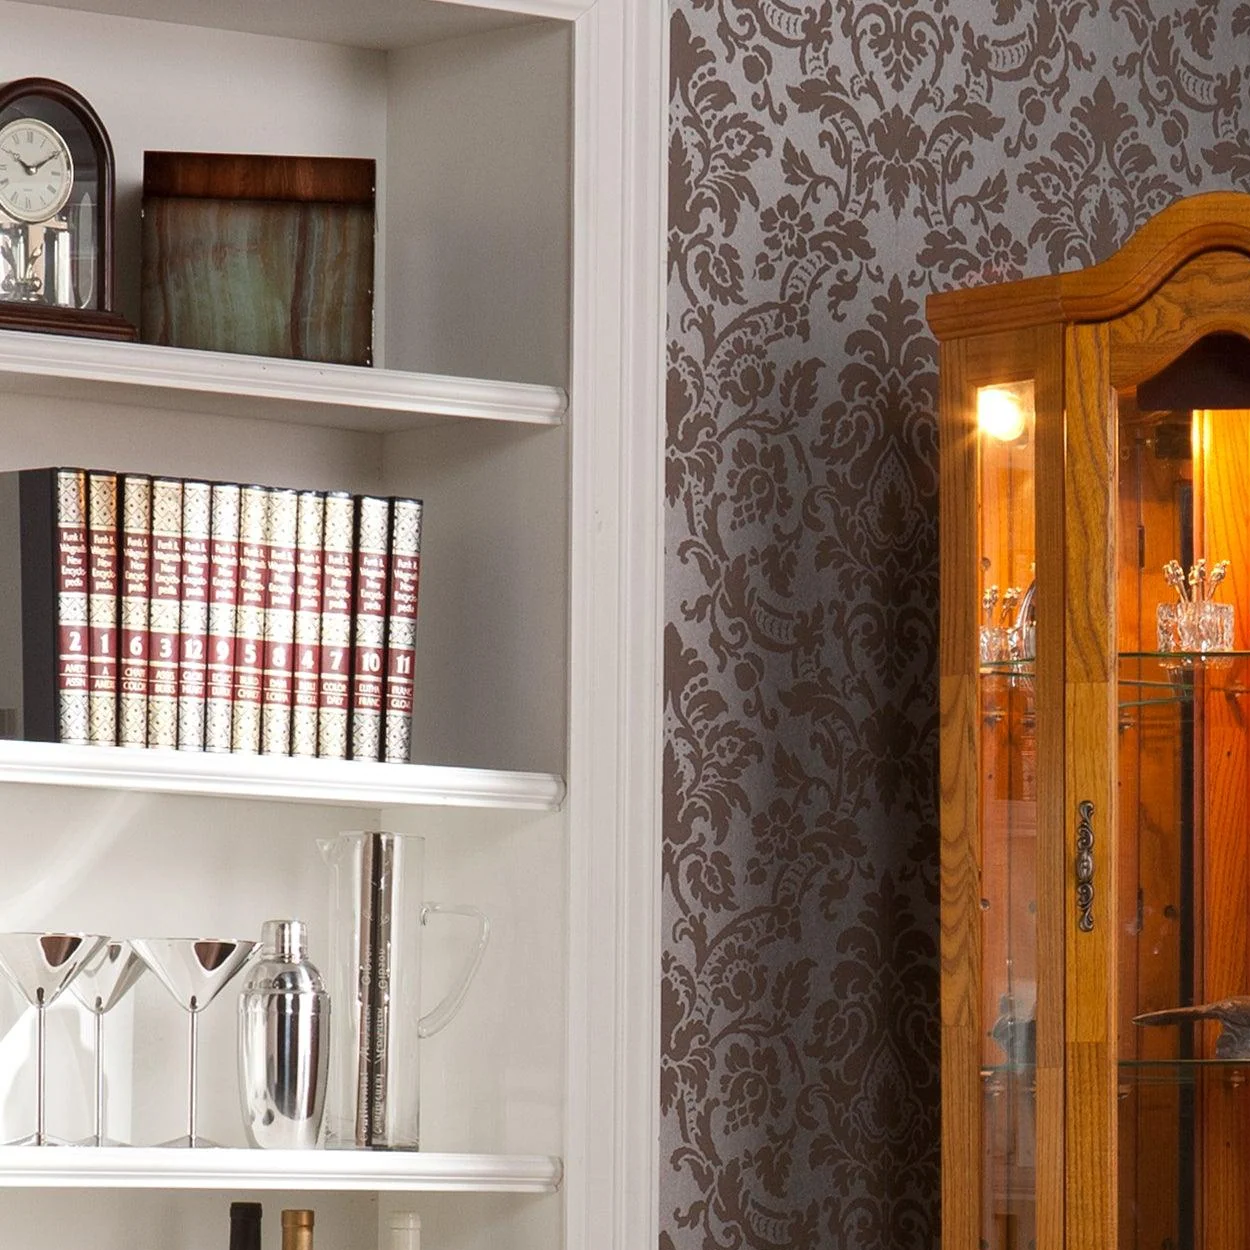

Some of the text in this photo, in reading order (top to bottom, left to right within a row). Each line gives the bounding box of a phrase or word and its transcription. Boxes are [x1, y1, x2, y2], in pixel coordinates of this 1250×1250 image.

[69, 631, 82, 651] 2
[100, 633, 109, 654] 1
[130, 636, 143, 656] 6
[159, 638, 173, 658] 3
[184, 638, 203, 659] 12
[216, 640, 230, 661] 9
[244, 643, 256, 664] 5
[272, 646, 286, 667] 8
[301, 649, 315, 669] 4
[329, 649, 343, 671] 7
[362, 651, 380, 672] 10
[396, 654, 411, 674] 11
[102, 666, 109, 675] A
